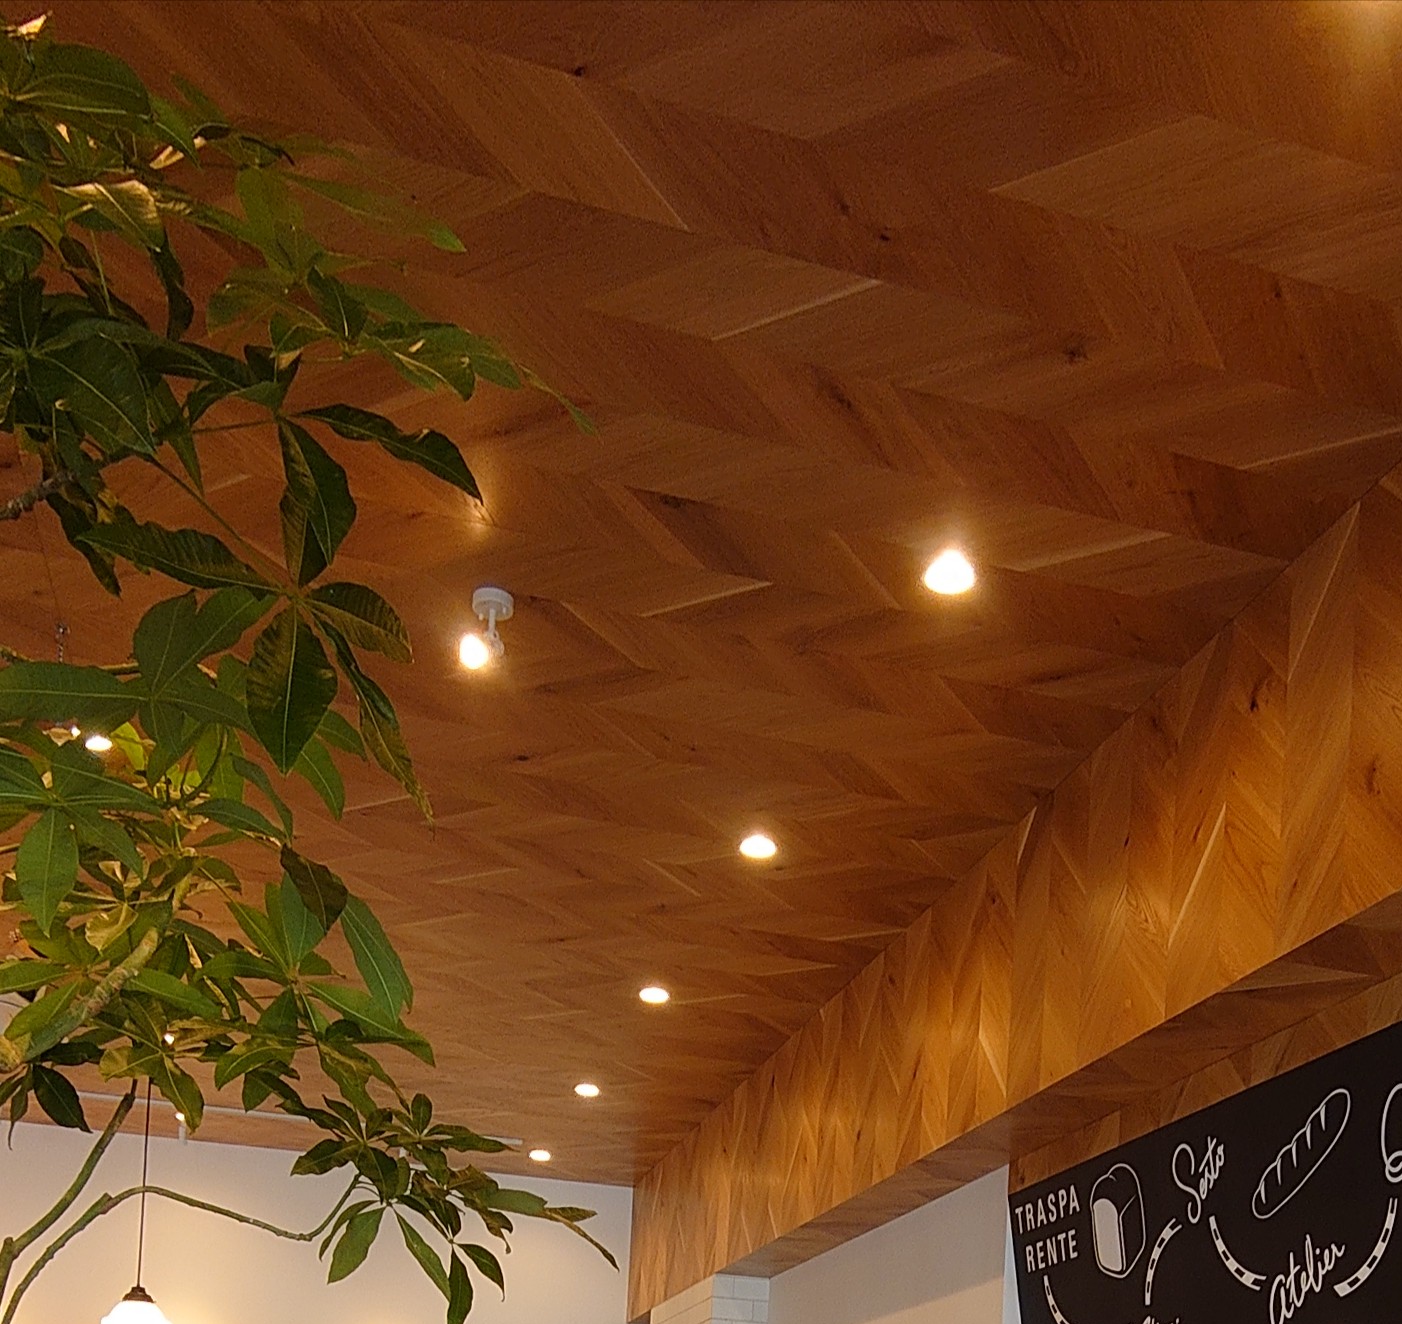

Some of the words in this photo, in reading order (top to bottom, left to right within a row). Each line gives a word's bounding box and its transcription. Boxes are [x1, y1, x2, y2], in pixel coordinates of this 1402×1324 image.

[1171, 1136, 1226, 1224] Sesto
[1014, 1184, 1080, 1234] TRASPA
[1025, 1233, 1079, 1273] RENTE
